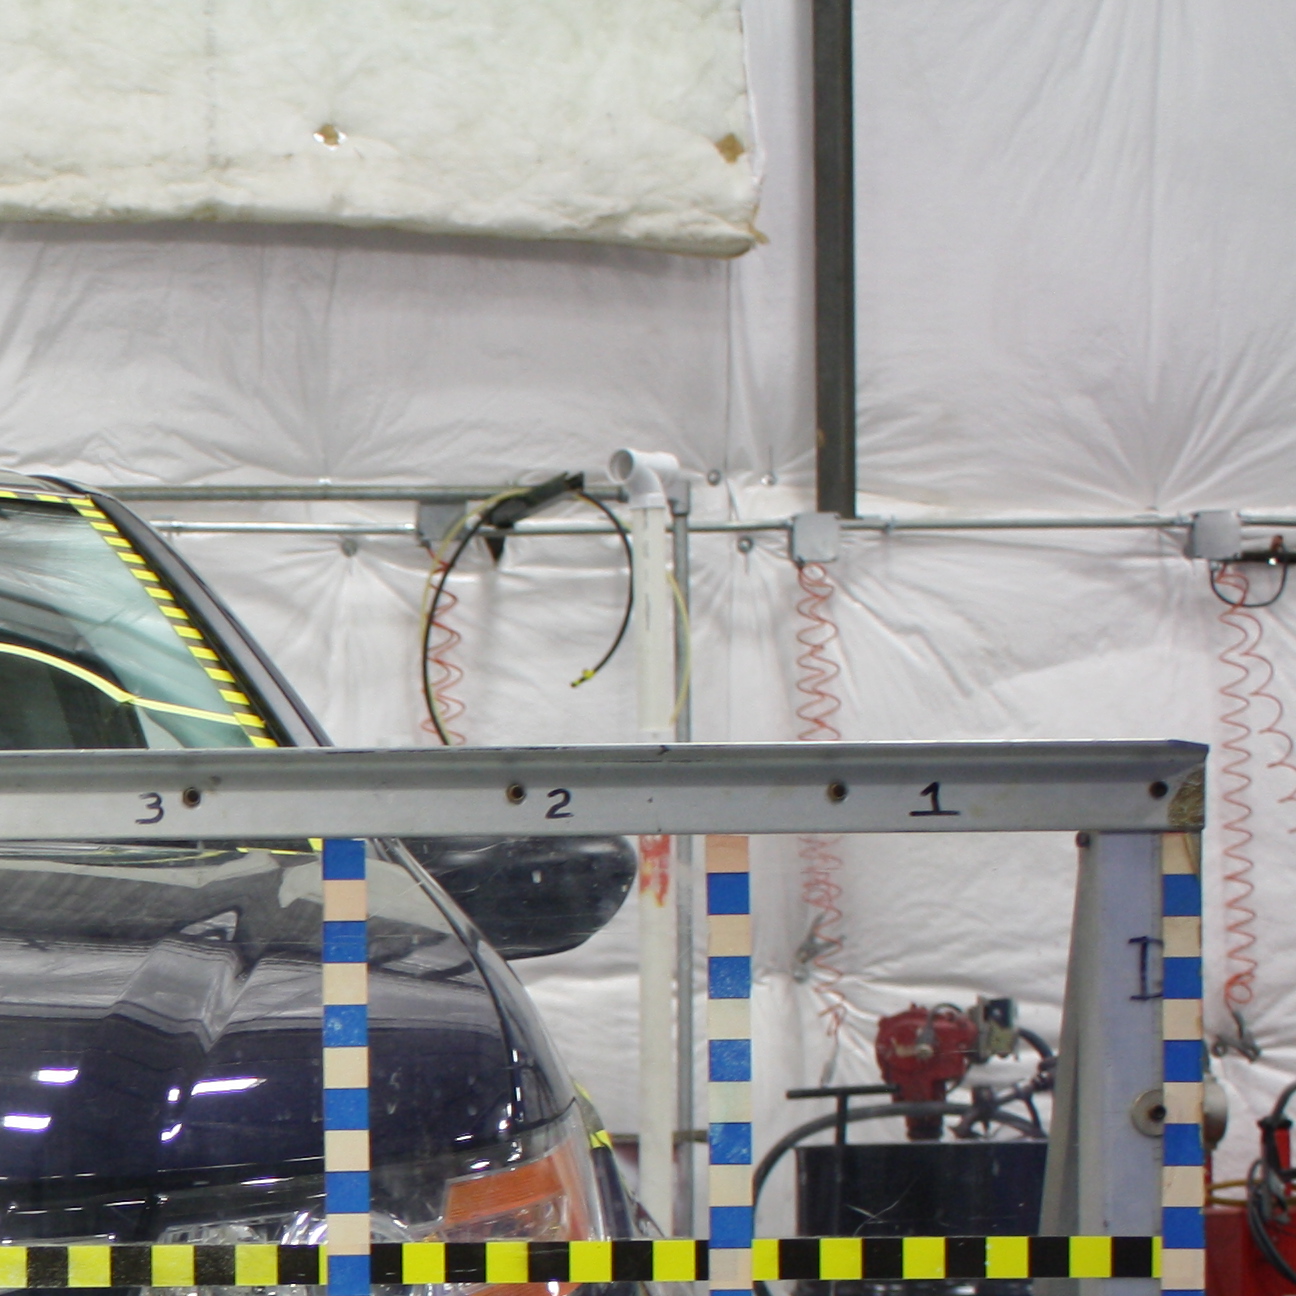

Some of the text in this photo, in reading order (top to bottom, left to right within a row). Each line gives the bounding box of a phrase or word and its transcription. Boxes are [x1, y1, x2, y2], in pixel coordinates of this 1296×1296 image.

[135, 791, 165, 825] 3
[545, 787, 573, 819] 2
[909, 780, 960, 817] 1
